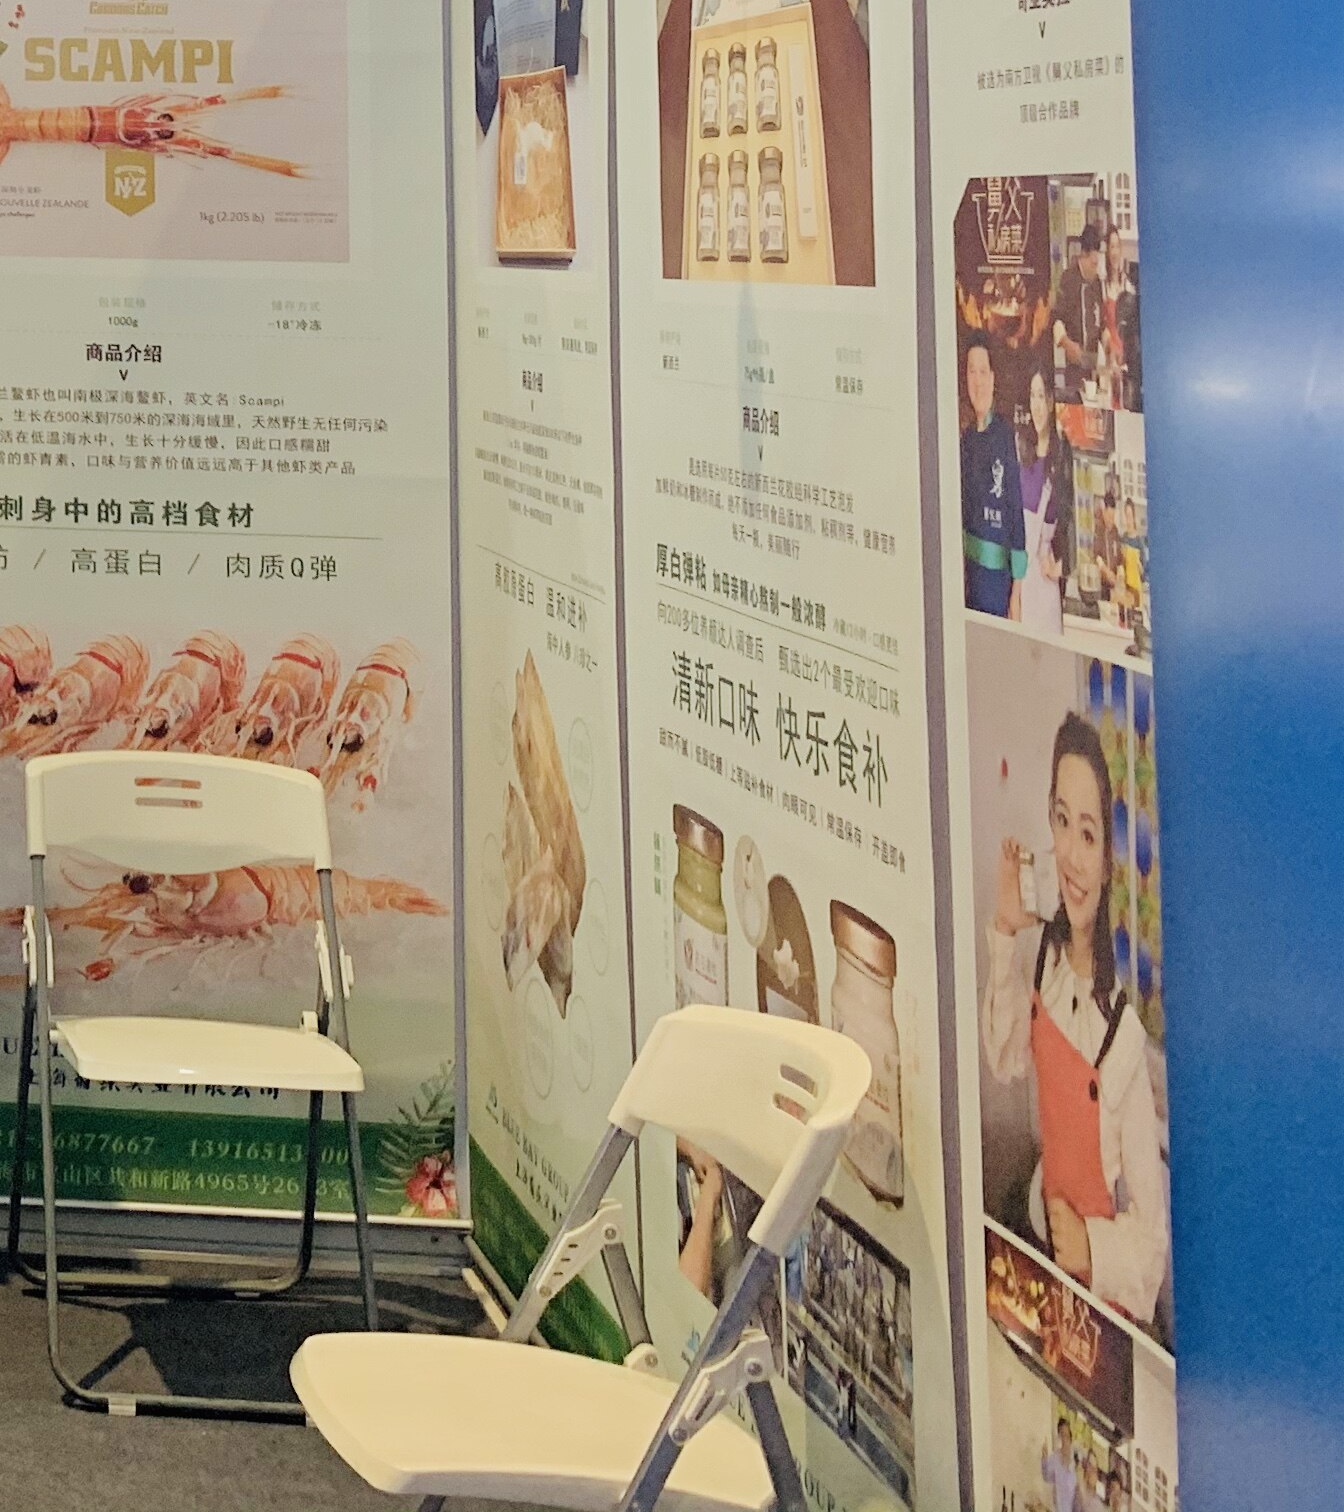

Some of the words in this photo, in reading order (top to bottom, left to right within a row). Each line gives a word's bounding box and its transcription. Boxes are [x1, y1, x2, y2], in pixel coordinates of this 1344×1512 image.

[23, 36, 236, 85] SCAMPI
[107, 315, 139, 329] 1000g
[85, 342, 163, 364] 商品介绍
[742, 405, 780, 437] 商品介绍
[70, 547, 163, 577] 高蛋白
[225, 553, 339, 581] 肉质Q弹
[671, 649, 762, 748] 清新口味
[775, 691, 890, 809] 快乐食补
